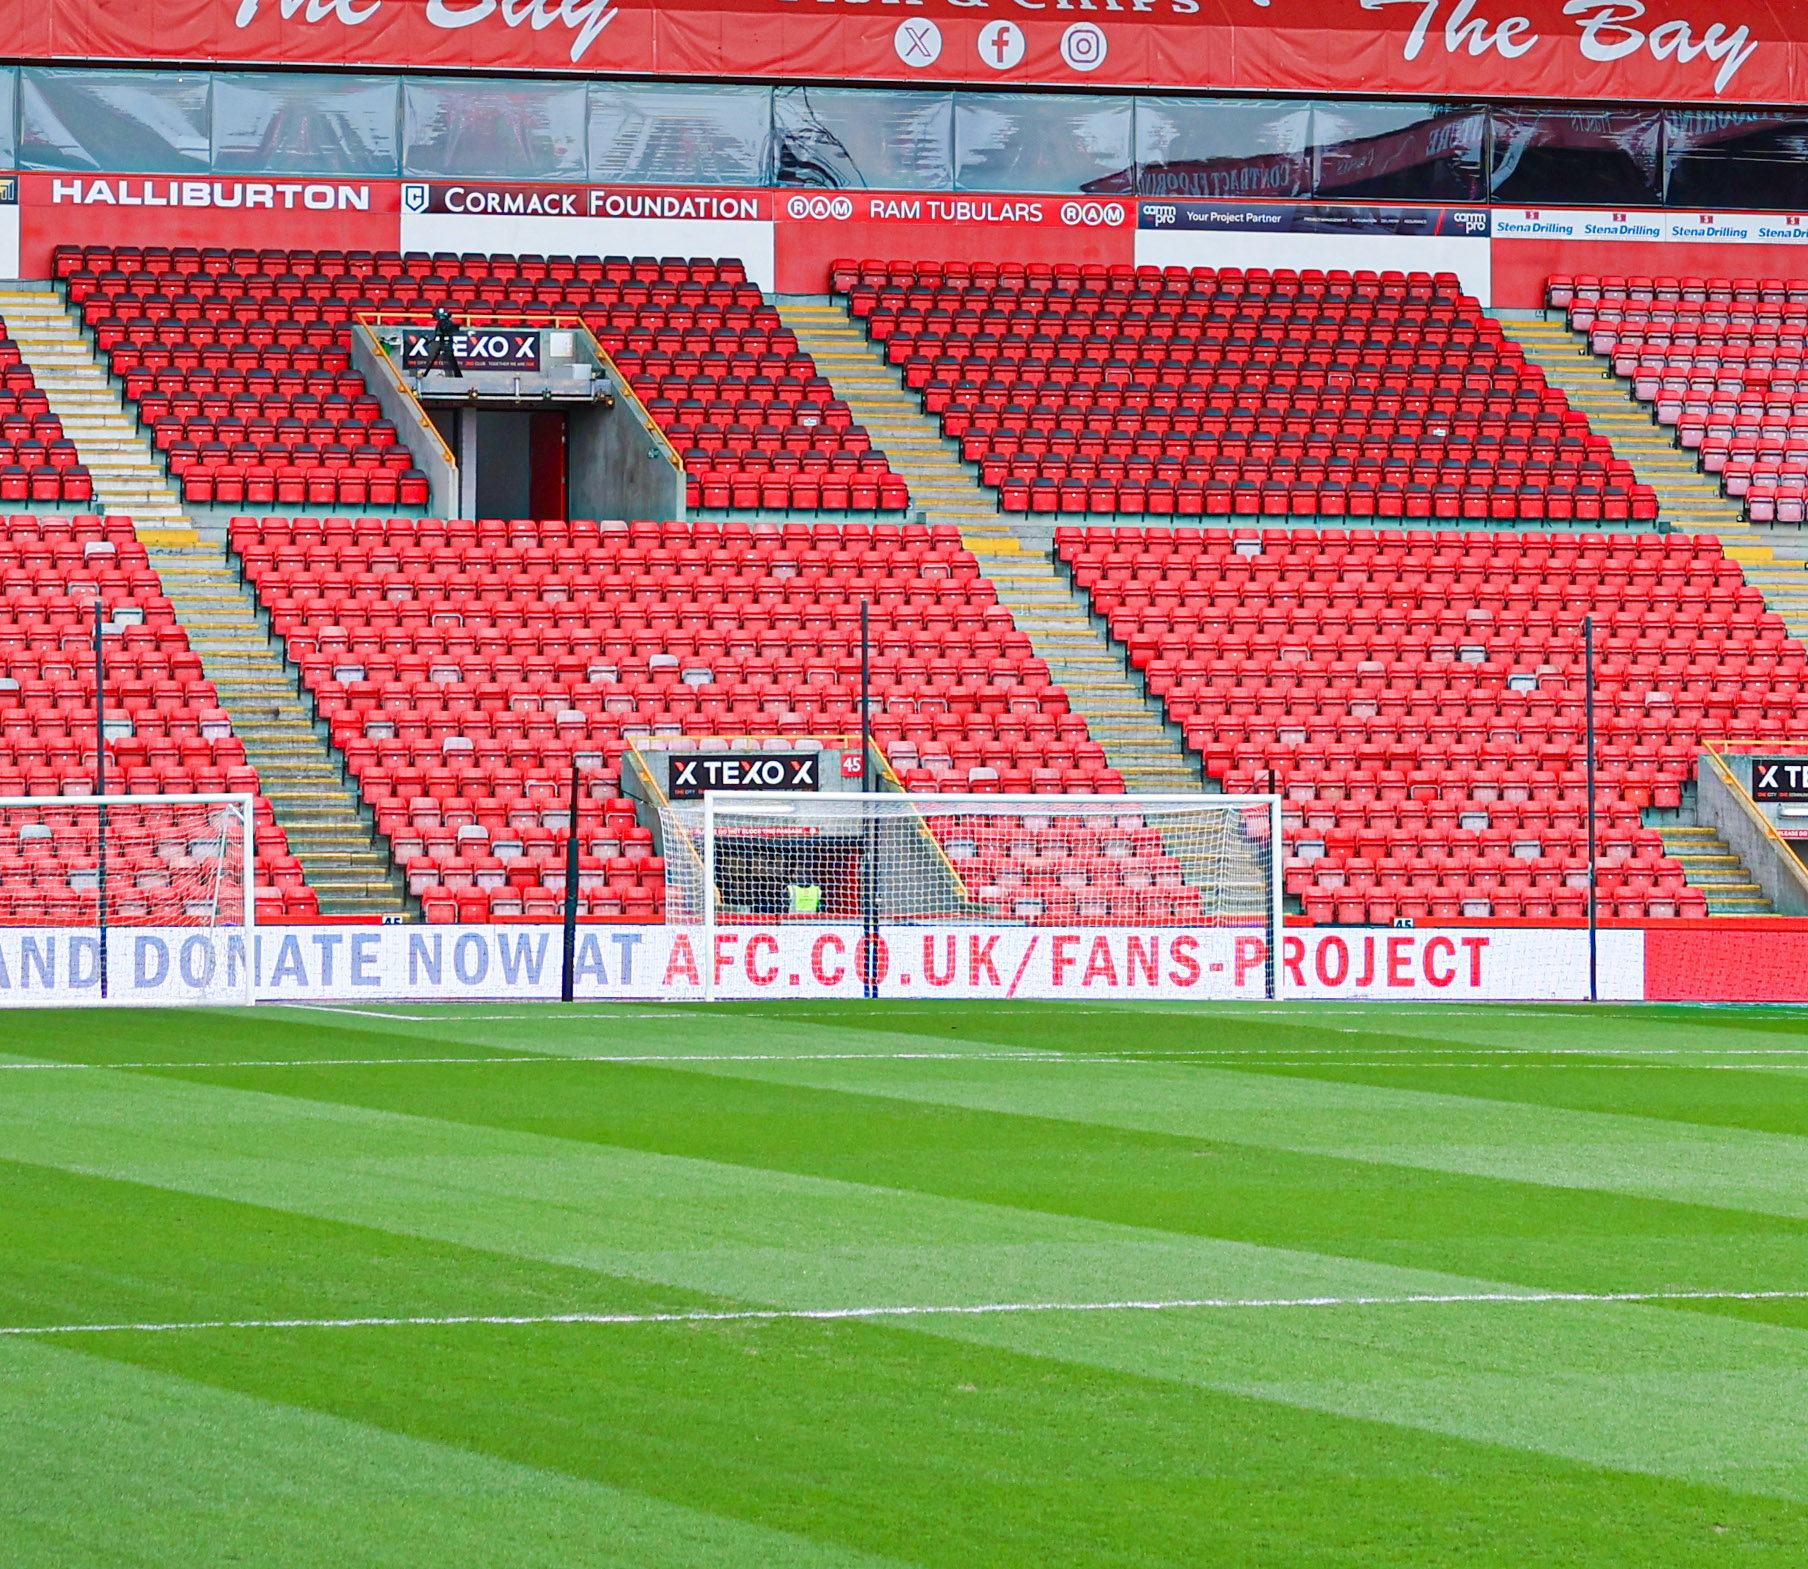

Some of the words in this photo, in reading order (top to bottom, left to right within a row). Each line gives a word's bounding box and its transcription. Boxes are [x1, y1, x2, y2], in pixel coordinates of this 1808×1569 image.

[52, 179, 369, 210] HALLIBURTON
[788, 196, 853, 220] RAM
[870, 200, 920, 219] RAM
[926, 201, 1043, 222] TUBULARS
[1060, 202, 1125, 226] RAM
[1155, 215, 1175, 226] pro
[1186, 211, 1208, 222] Your
[1210, 212, 1243, 224] Project
[1246, 213, 1281, 224] Partner
[1465, 221, 1486, 233] pro
[1497, 222, 1531, 232] Stena
[1532, 224, 1574, 235] Drilling
[1584, 224, 1618, 234] Stena
[1620, 226, 1660, 237] Drilling
[1672, 226, 1705, 236] Stena
[1706, 228, 1748, 239] Drilling
[1758, 228, 1792, 238] Stena
[843, 757, 861, 771] 45
[675, 761, 697, 784] X
[703, 761, 784, 784] TEXO
[791, 760, 813, 784] X
[1758, 765, 1779, 788] X
[133, 933, 381, 989] DONATE
[407, 932, 550, 985] NOW
[573, 933, 641, 985] AT
